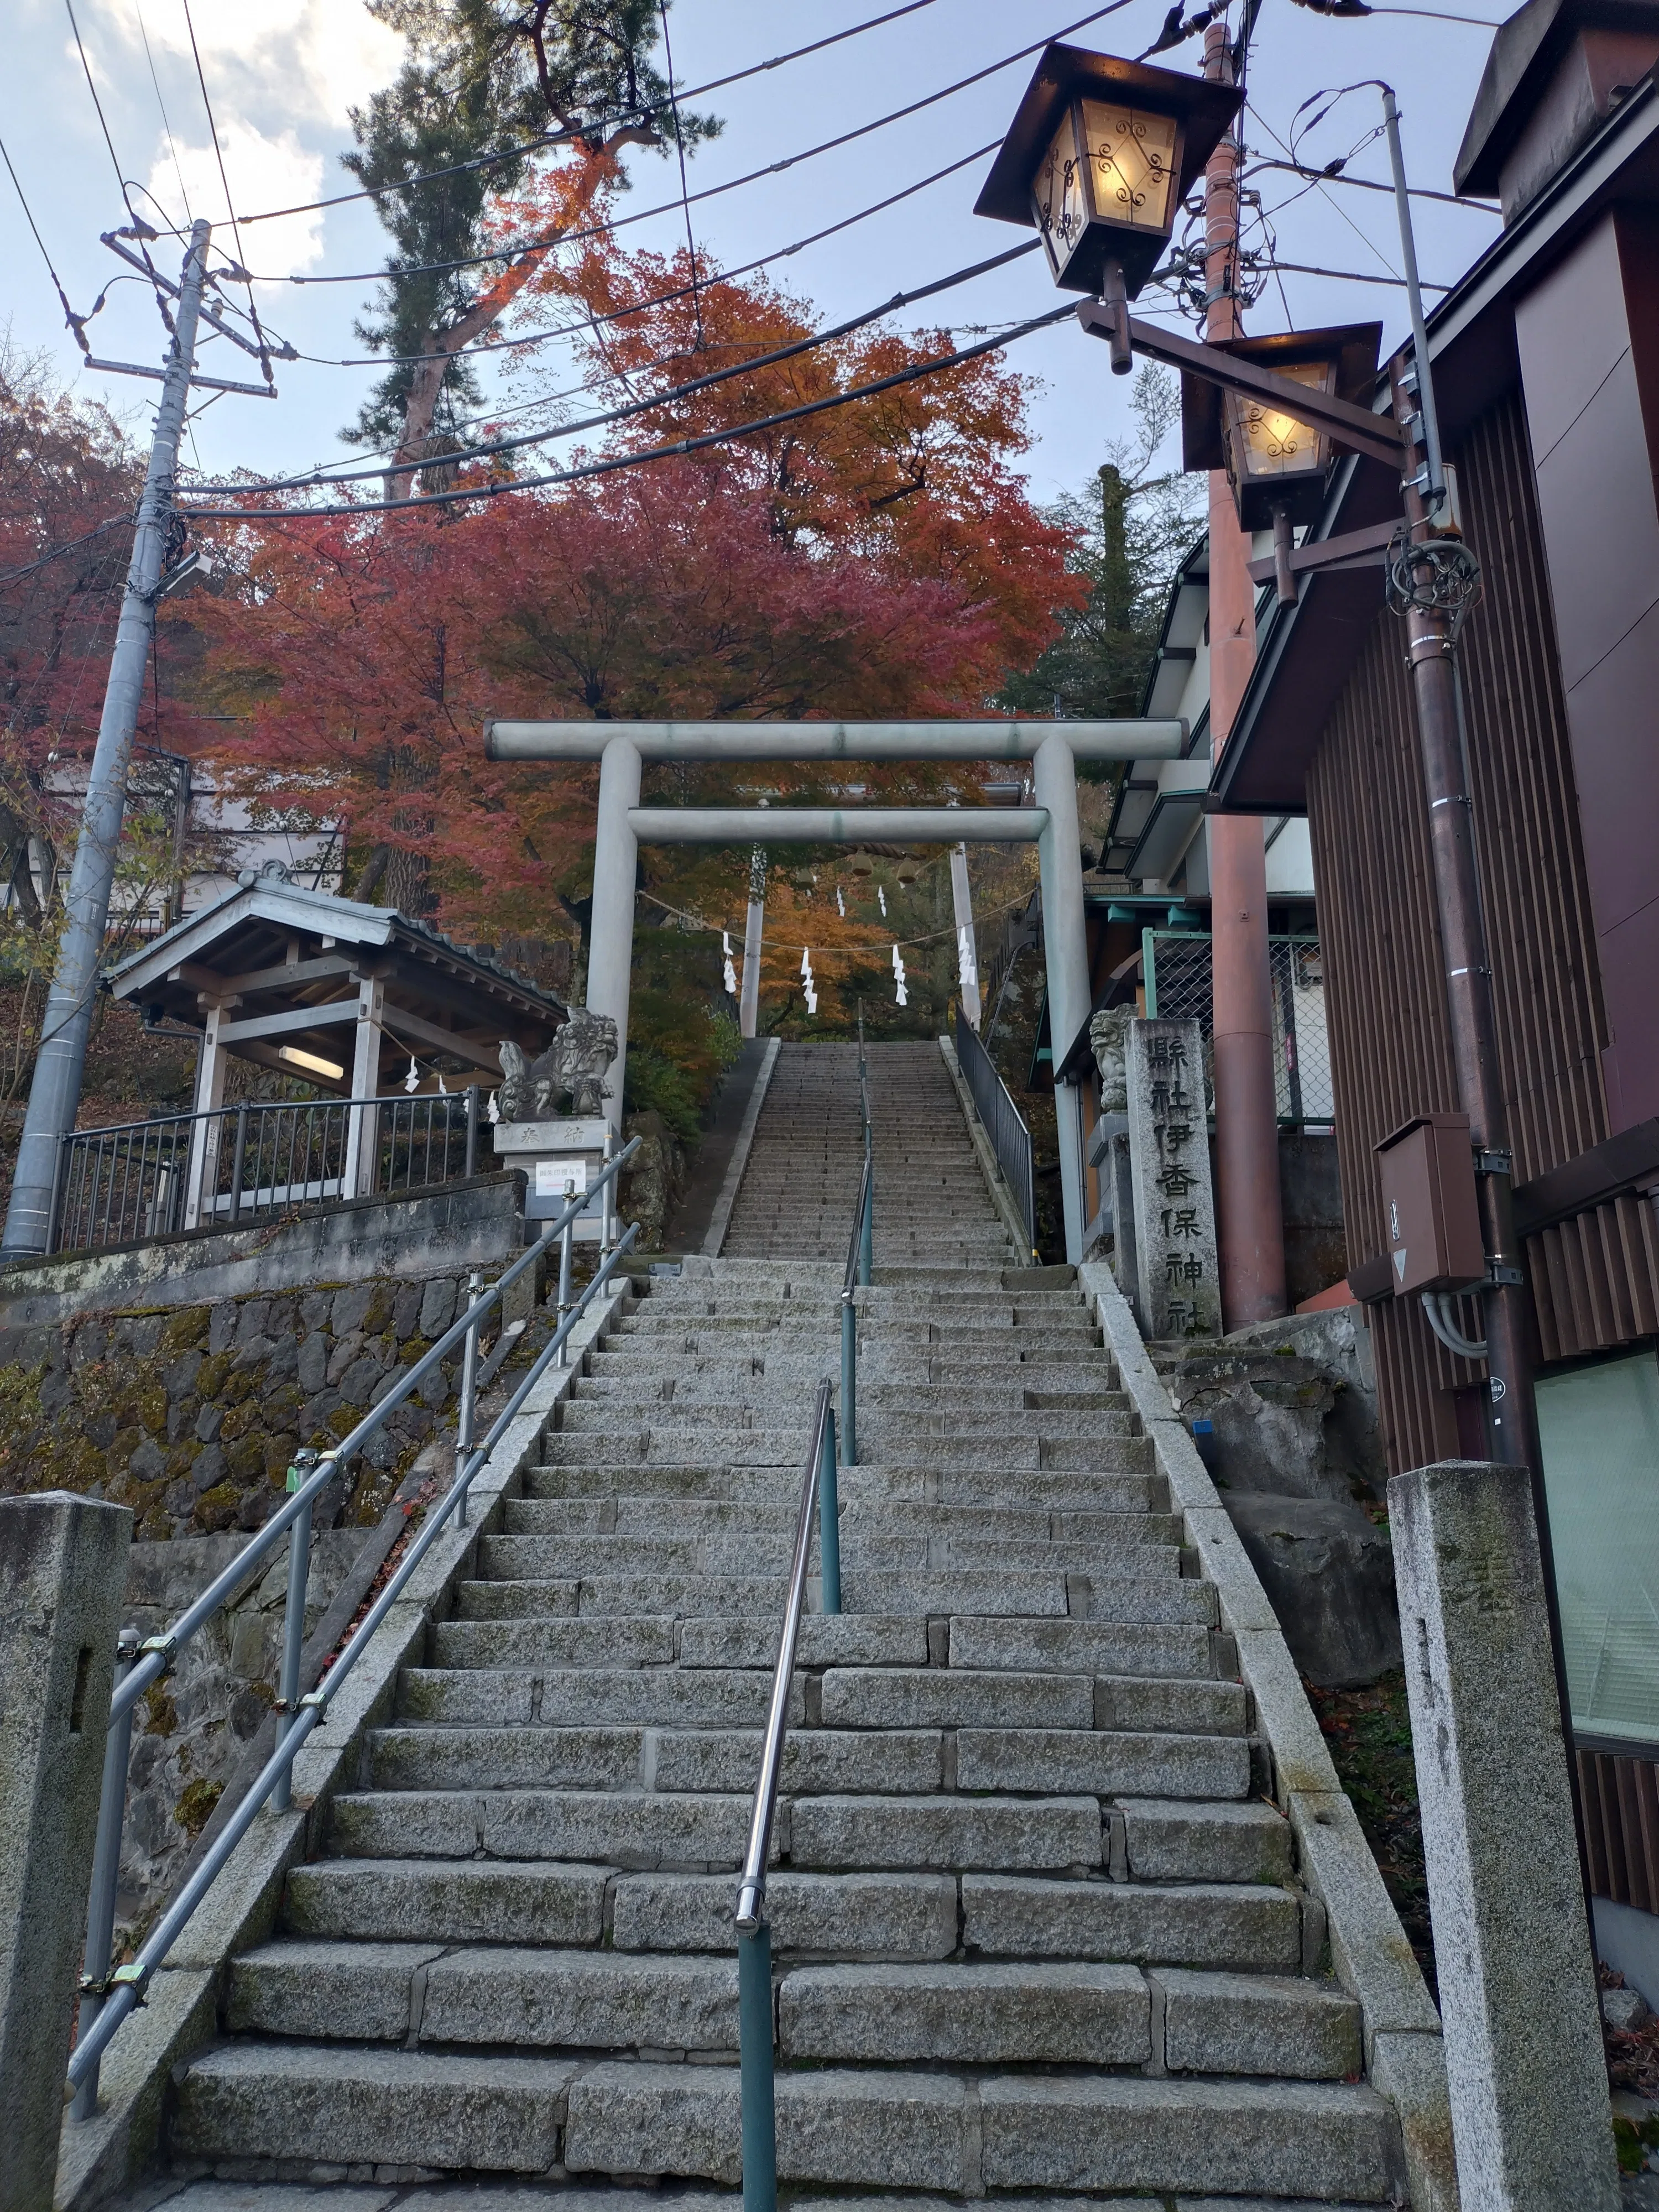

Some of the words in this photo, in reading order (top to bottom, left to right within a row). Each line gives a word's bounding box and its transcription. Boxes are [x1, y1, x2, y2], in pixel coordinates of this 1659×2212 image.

[520, 1126, 585, 1146] 奉納
[540, 1168, 582, 1177] 御朱印授与所
[1147, 1037, 1208, 1335] 縣社伊香保神社
